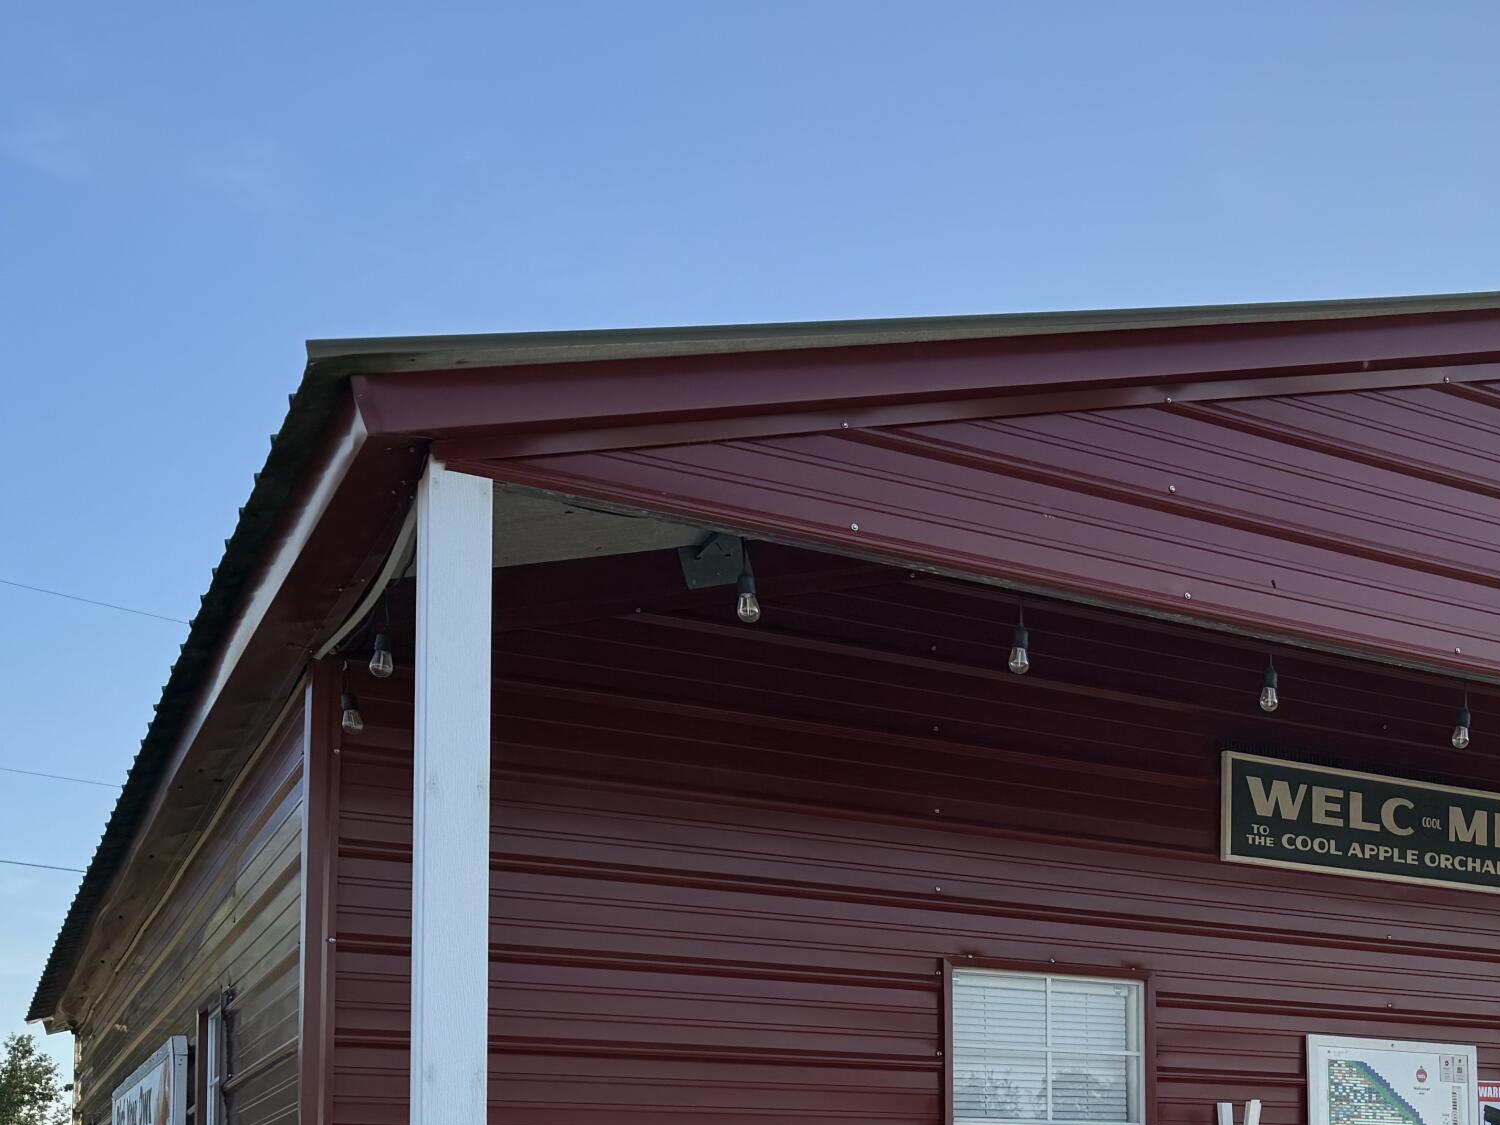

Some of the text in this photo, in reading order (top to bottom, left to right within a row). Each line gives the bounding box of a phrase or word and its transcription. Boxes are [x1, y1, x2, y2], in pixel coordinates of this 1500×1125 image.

[1251, 824, 1270, 835] TO
[1422, 816, 1442, 830] COOL
[1246, 834, 1275, 847] THE
[1281, 833, 1342, 856] COOL
[1347, 842, 1419, 865] APPLE
